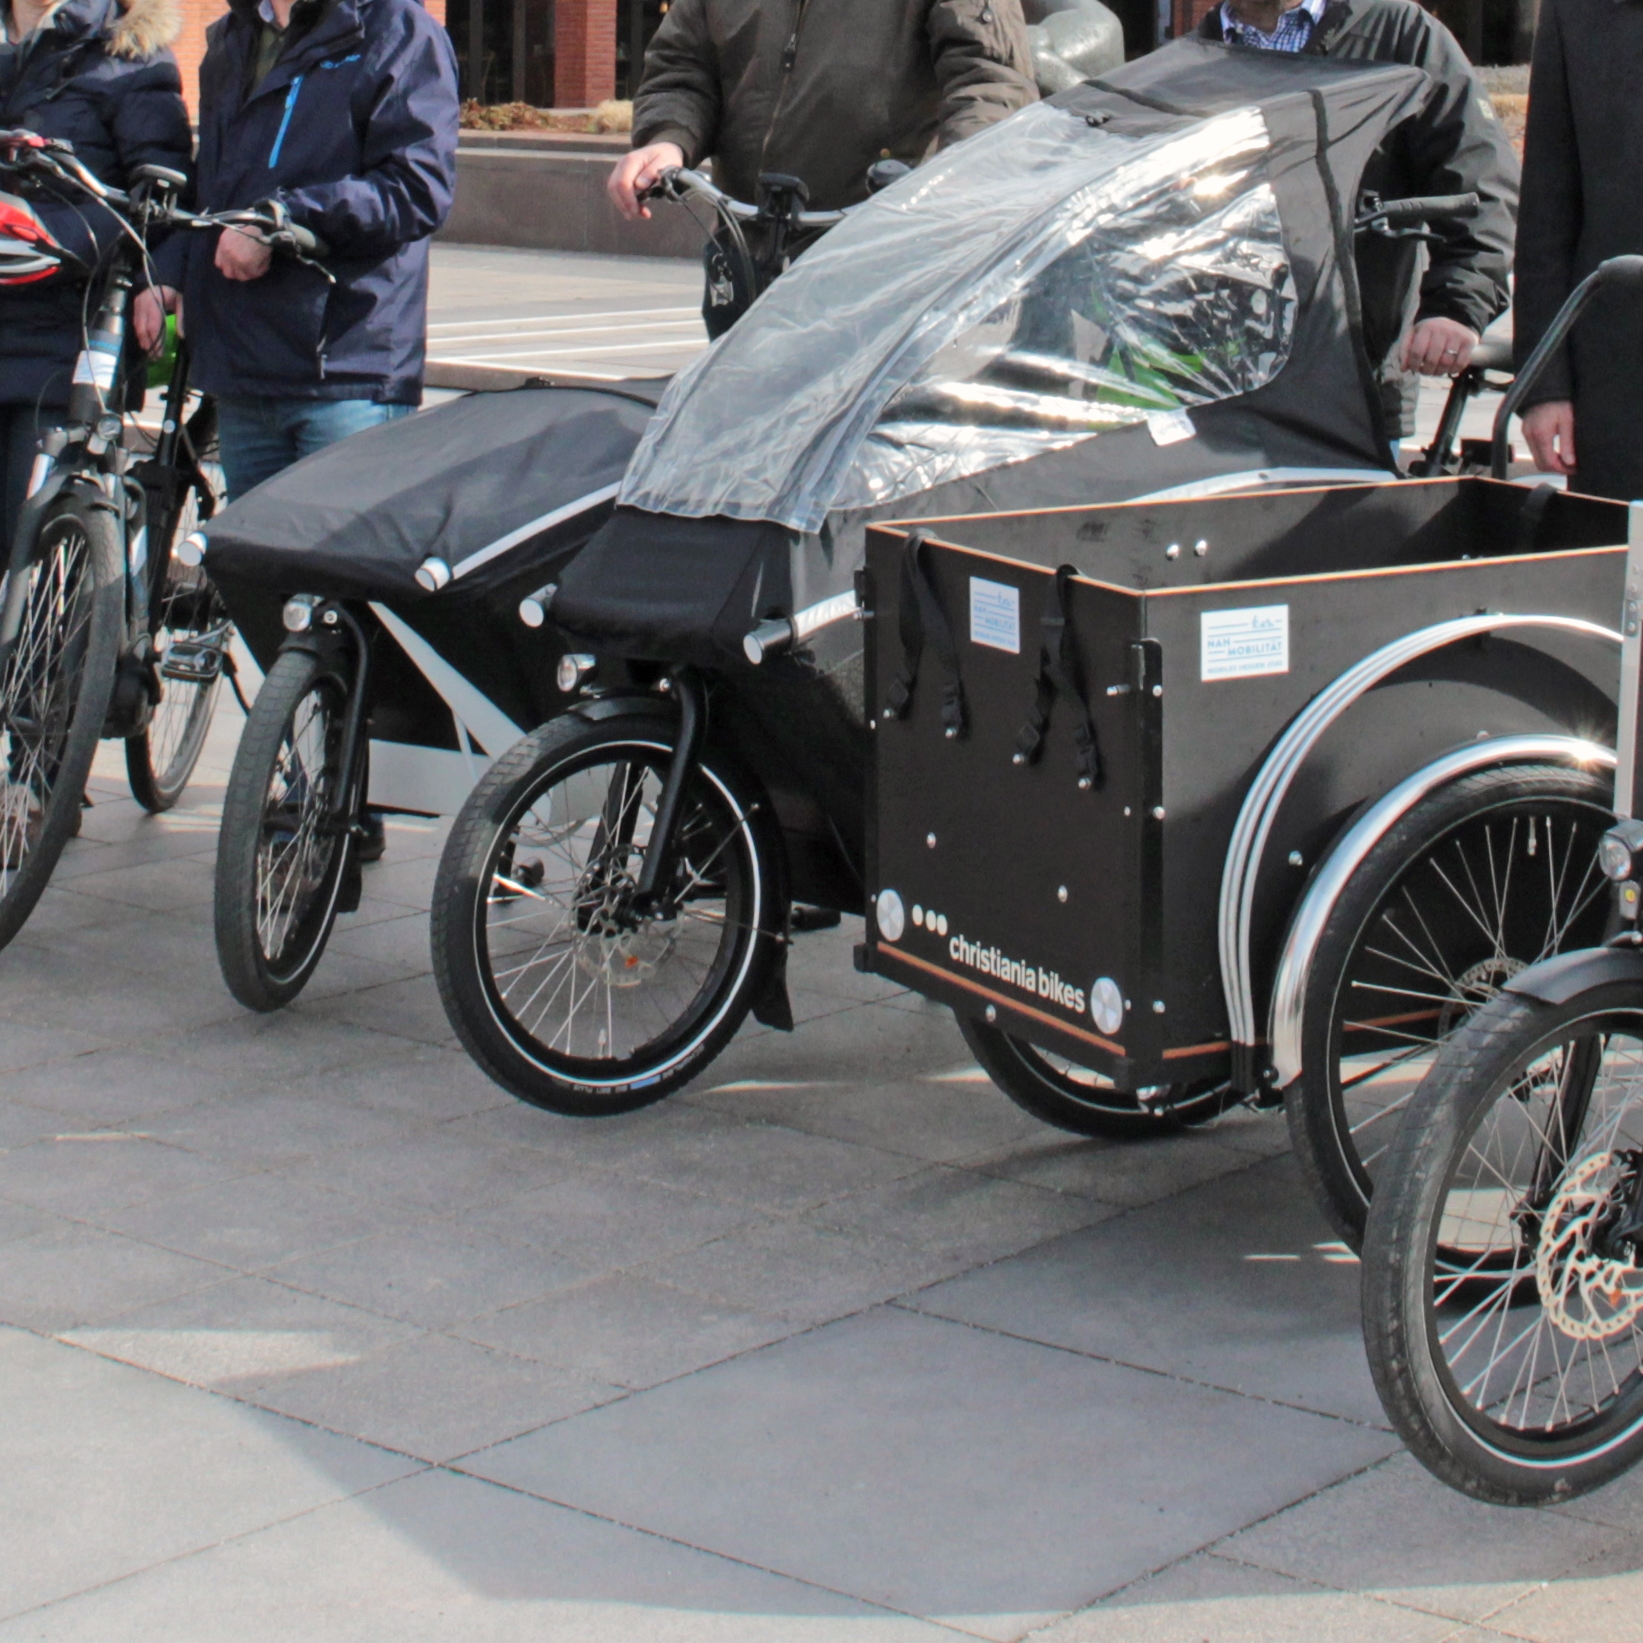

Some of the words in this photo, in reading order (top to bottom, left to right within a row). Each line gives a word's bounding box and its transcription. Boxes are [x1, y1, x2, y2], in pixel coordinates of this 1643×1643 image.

[1207, 637, 1231, 648] NAH
[1227, 639, 1283, 656] MOBILITÄT
[948, 934, 1037, 993] christiania
[1037, 966, 1086, 1015] bikes
